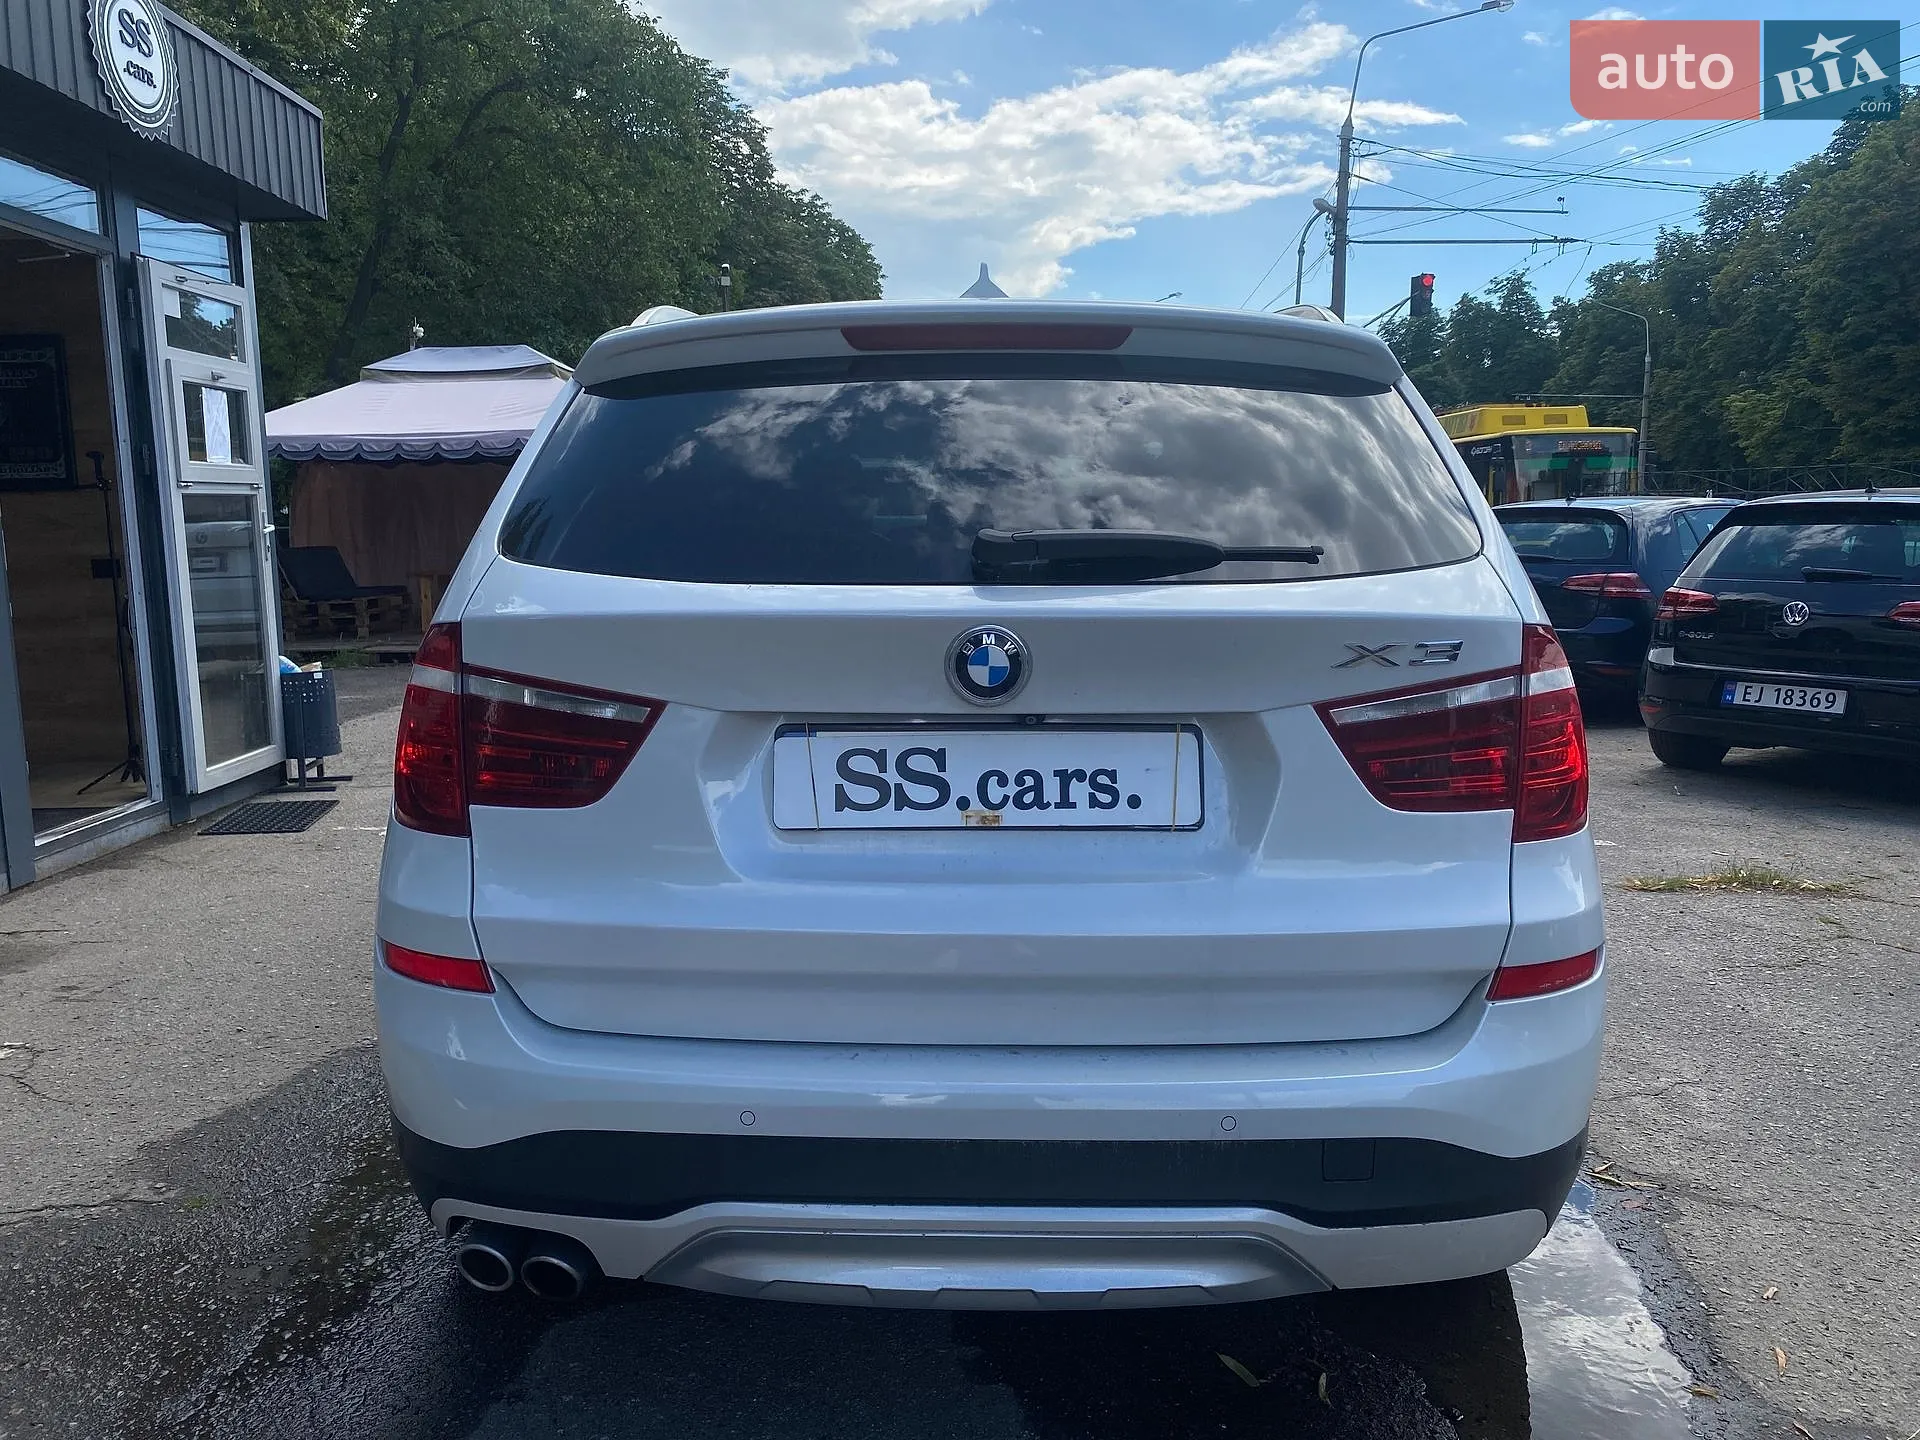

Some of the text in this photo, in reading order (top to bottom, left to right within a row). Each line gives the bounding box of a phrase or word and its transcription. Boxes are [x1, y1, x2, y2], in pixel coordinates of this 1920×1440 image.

[117, 7, 154, 58] SS
[962, 633, 1018, 655] BMW
[1330, 639, 1464, 669] X3
[1742, 684, 1838, 710] EJ 18369
[834, 746, 1143, 813] SS.cars.
